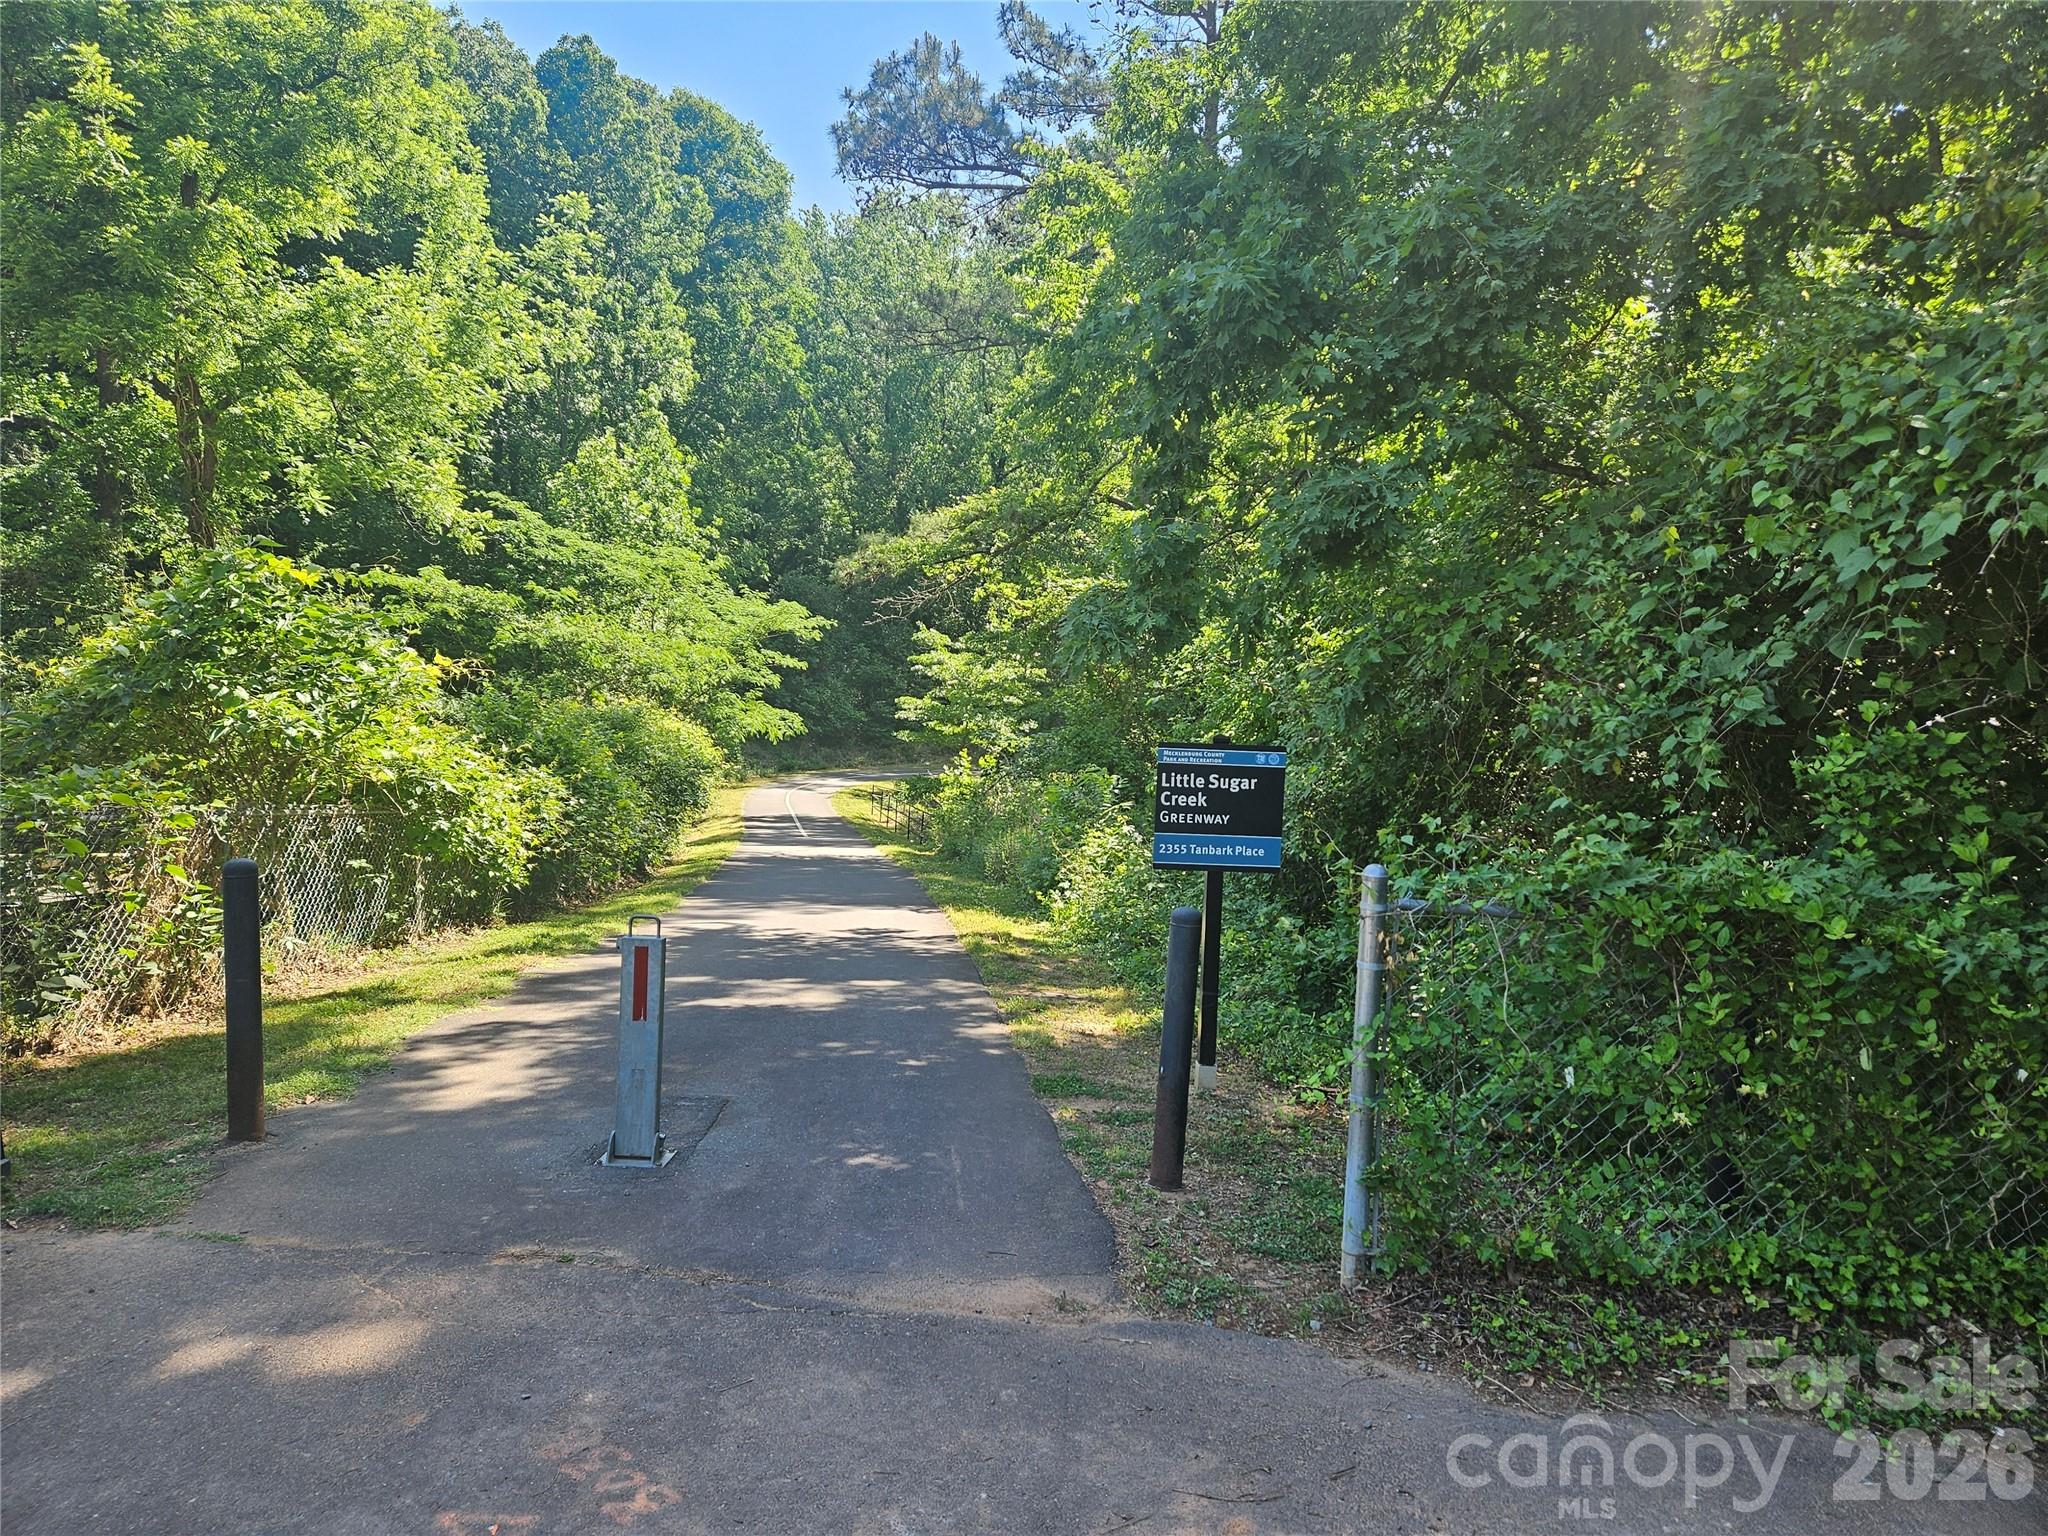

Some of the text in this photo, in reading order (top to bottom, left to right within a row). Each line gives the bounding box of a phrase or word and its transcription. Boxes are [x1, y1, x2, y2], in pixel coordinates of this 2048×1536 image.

[1161, 772, 1258, 792] Little Sugar
[1160, 791, 1208, 807] Creek
[1160, 811, 1230, 825] GREENWAY
[1159, 844, 1265, 856] 2355 Tanbark Place
